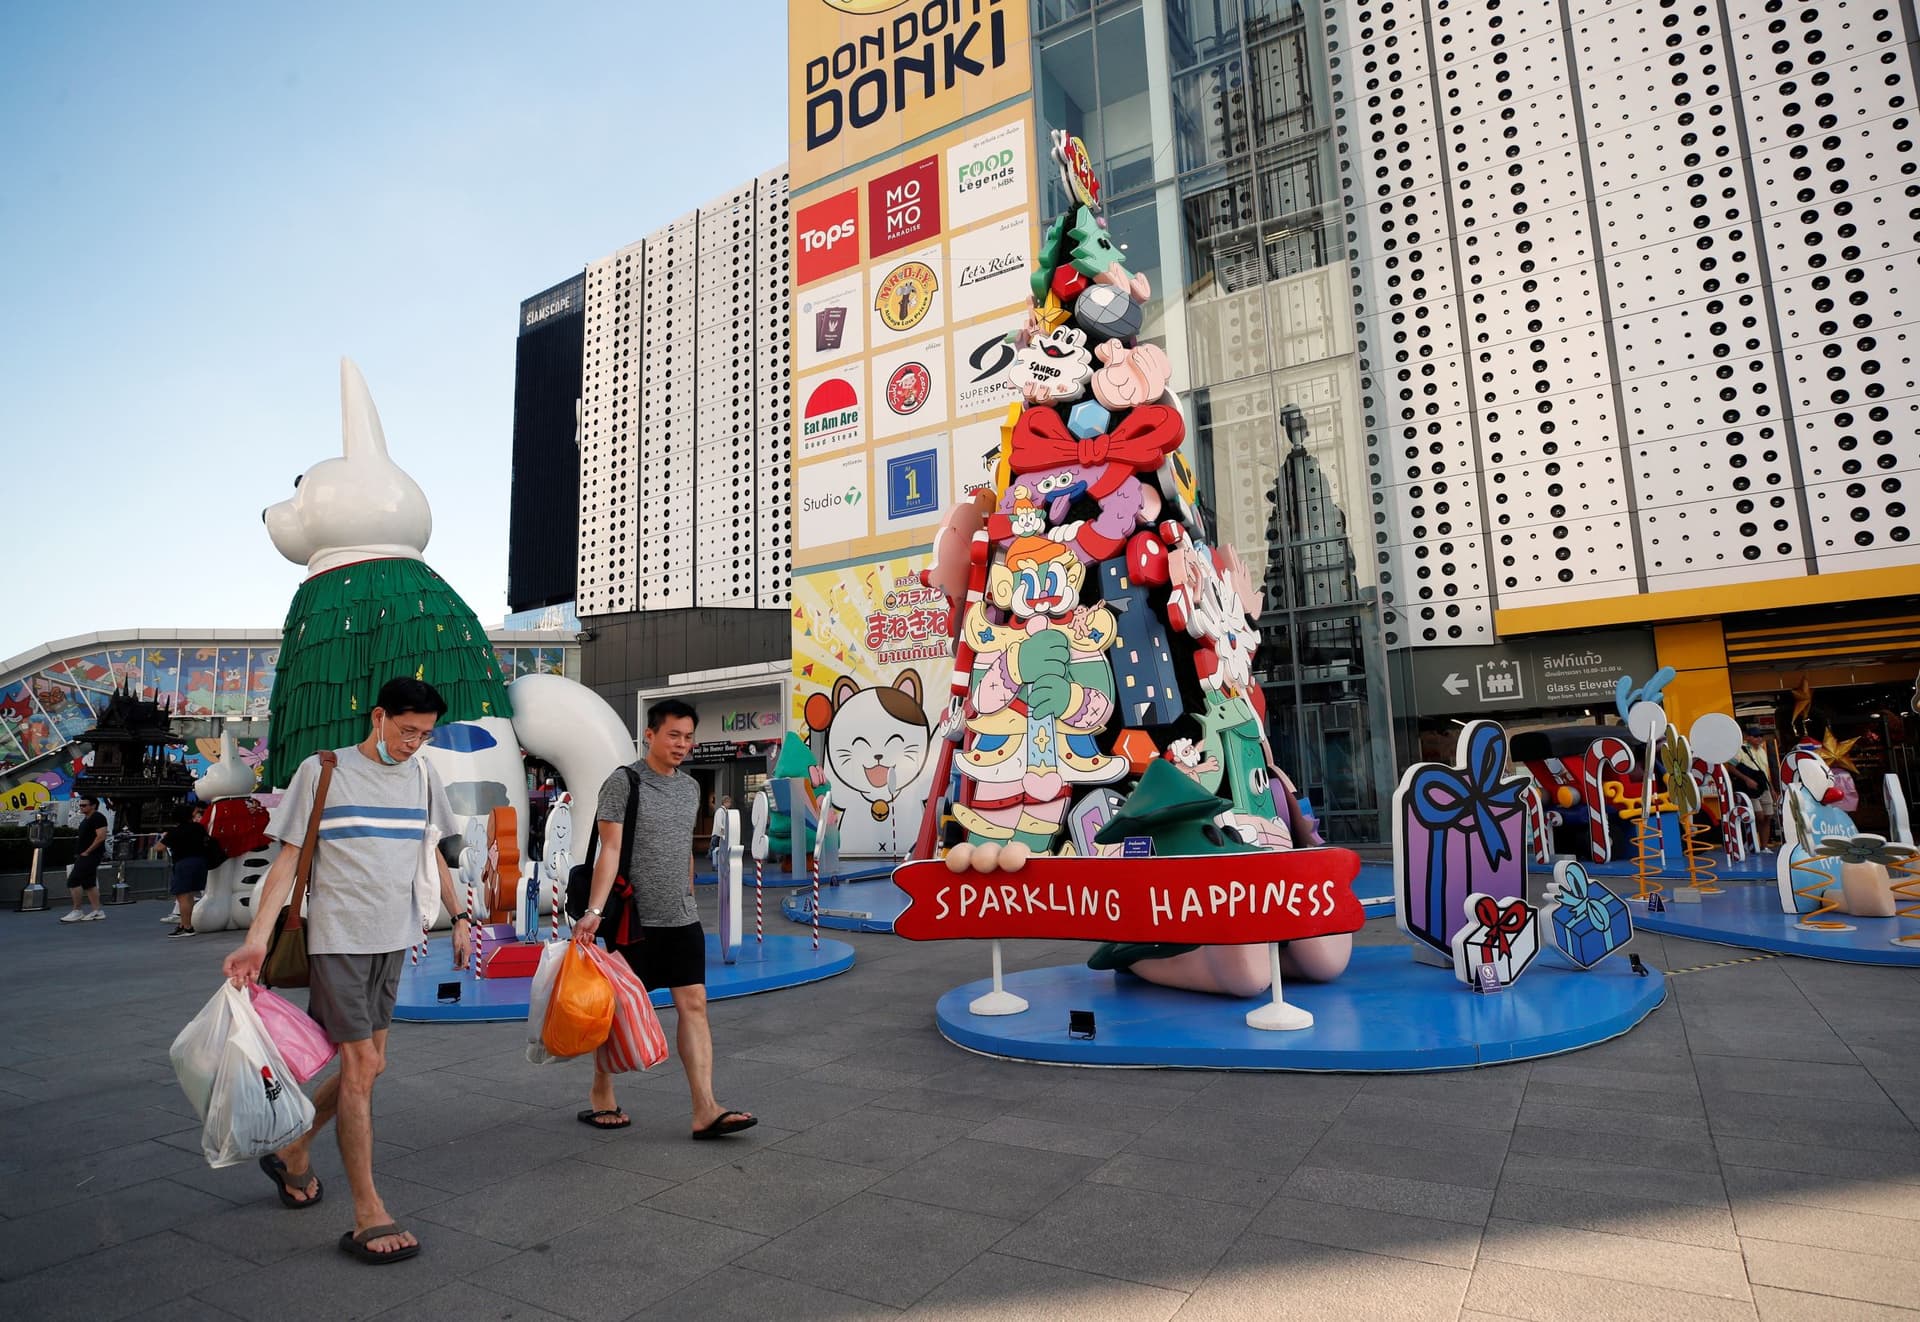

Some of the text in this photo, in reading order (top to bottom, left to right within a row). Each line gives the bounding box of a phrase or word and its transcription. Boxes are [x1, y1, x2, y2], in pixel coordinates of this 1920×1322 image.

[807, 27, 884, 95] DON
[806, 9, 1006, 152] DONKI
[959, 149, 1013, 183] FOOD
[959, 167, 1014, 193] Legends
[886, 180, 920, 208] MO
[887, 206, 921, 233] MO
[887, 223, 921, 241] PARADISE
[799, 218, 855, 253] Tops
[958, 264, 986, 288] Let's
[988, 252, 1023, 274] Relax
[1032, 372, 1051, 382] TOY
[804, 411, 858, 436] Eat Am Are
[803, 492, 842, 512] Studio
[1546, 683, 1576, 693] Glass
[721, 711, 758, 732] MBK
[936, 879, 1335, 926] SPARKLING HAPPINESS
